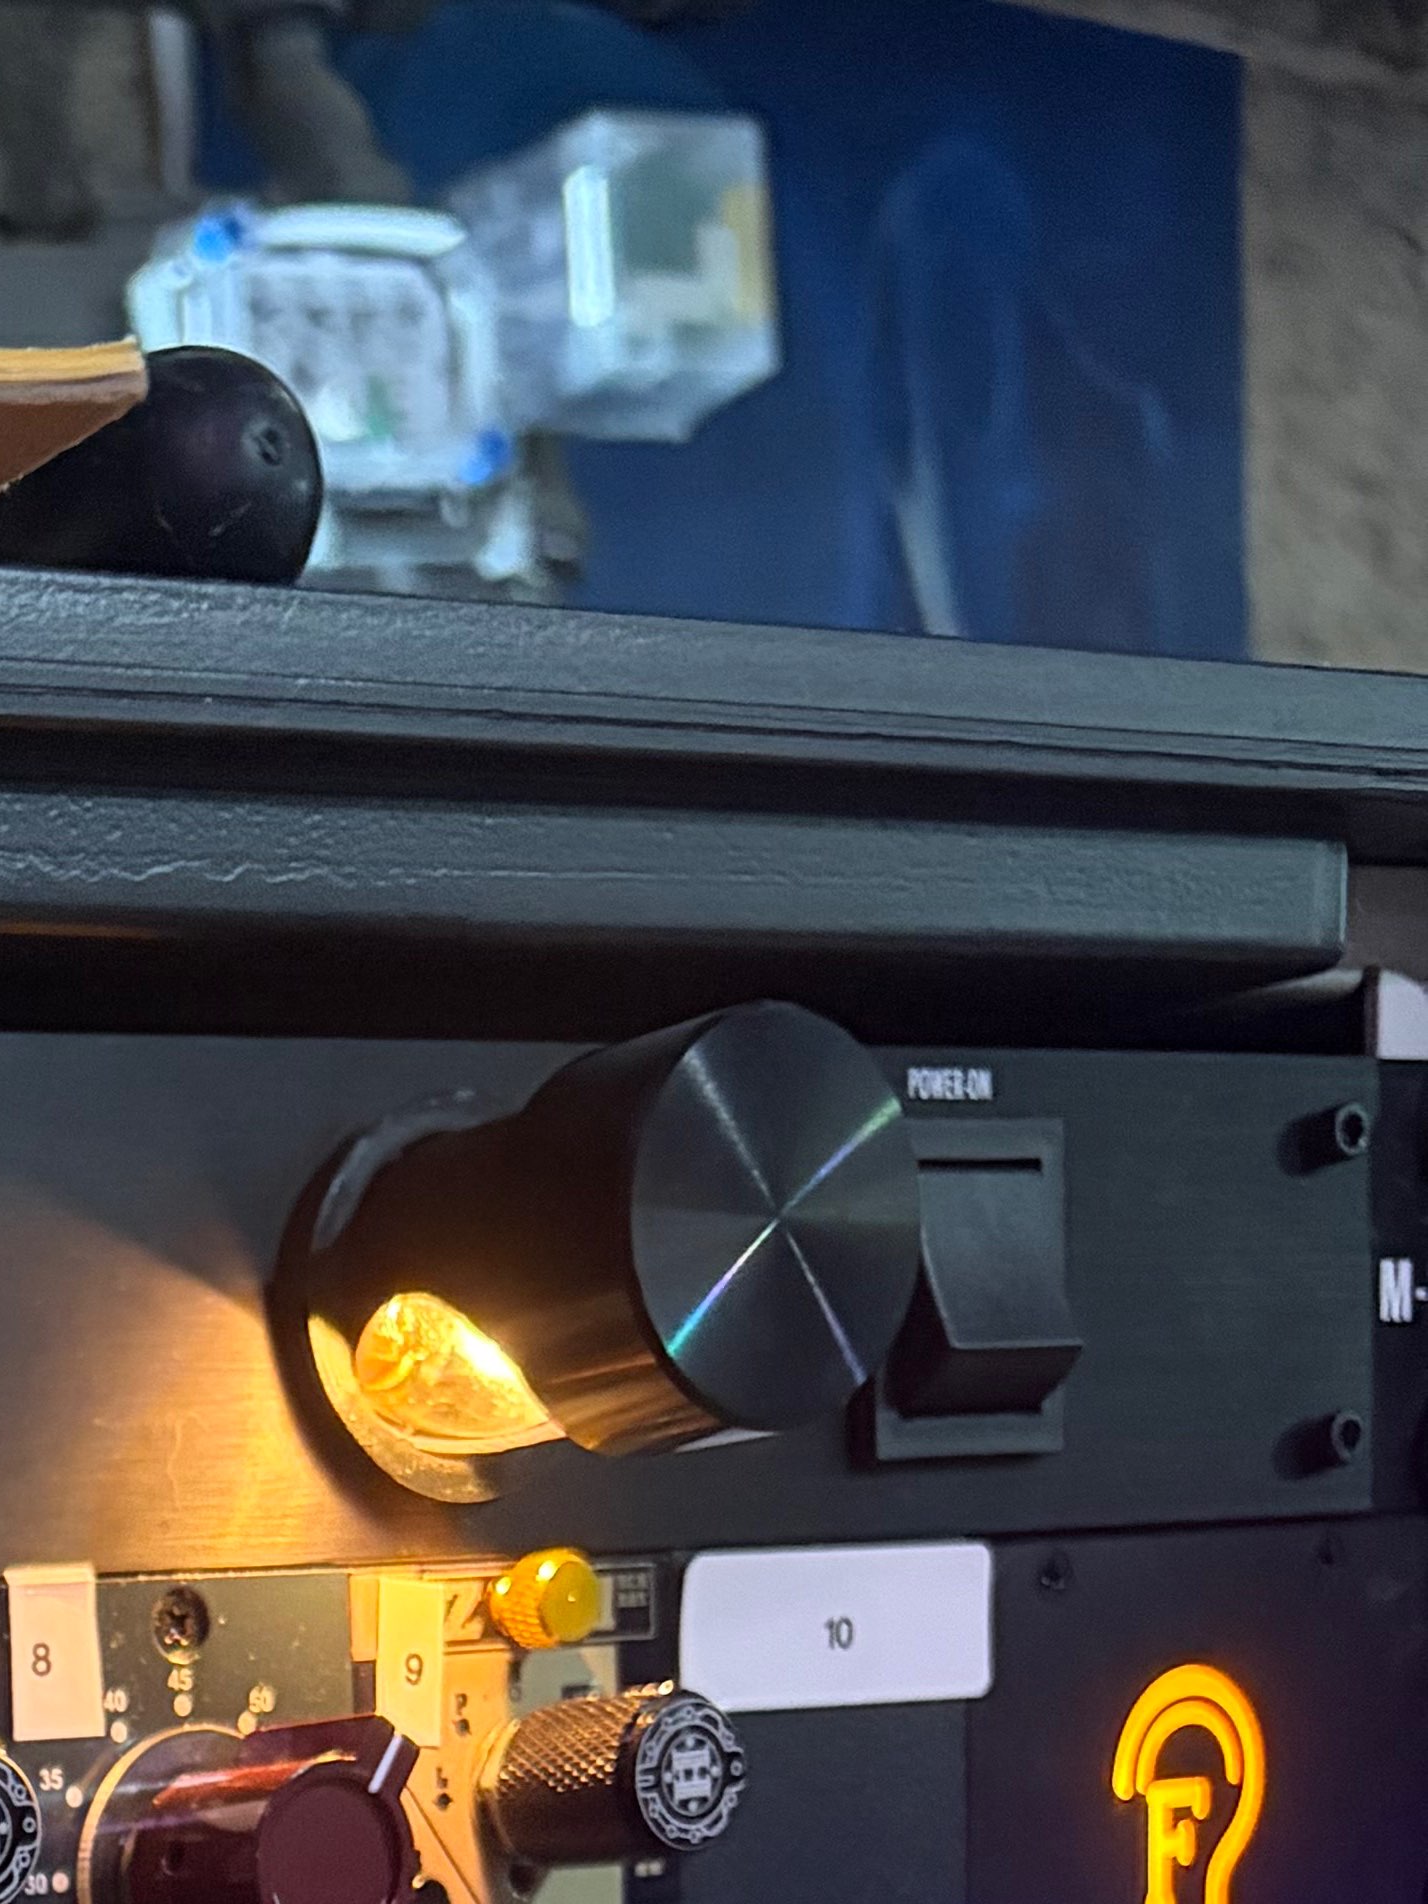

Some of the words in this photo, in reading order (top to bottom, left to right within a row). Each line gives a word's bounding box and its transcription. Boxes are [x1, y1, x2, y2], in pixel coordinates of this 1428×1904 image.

[824, 1618, 853, 1650] 10
[32, 1643, 52, 1676] 8
[405, 1654, 423, 1684] 9
[167, 1669, 193, 1690] 45
[40, 1769, 63, 1790] 35
